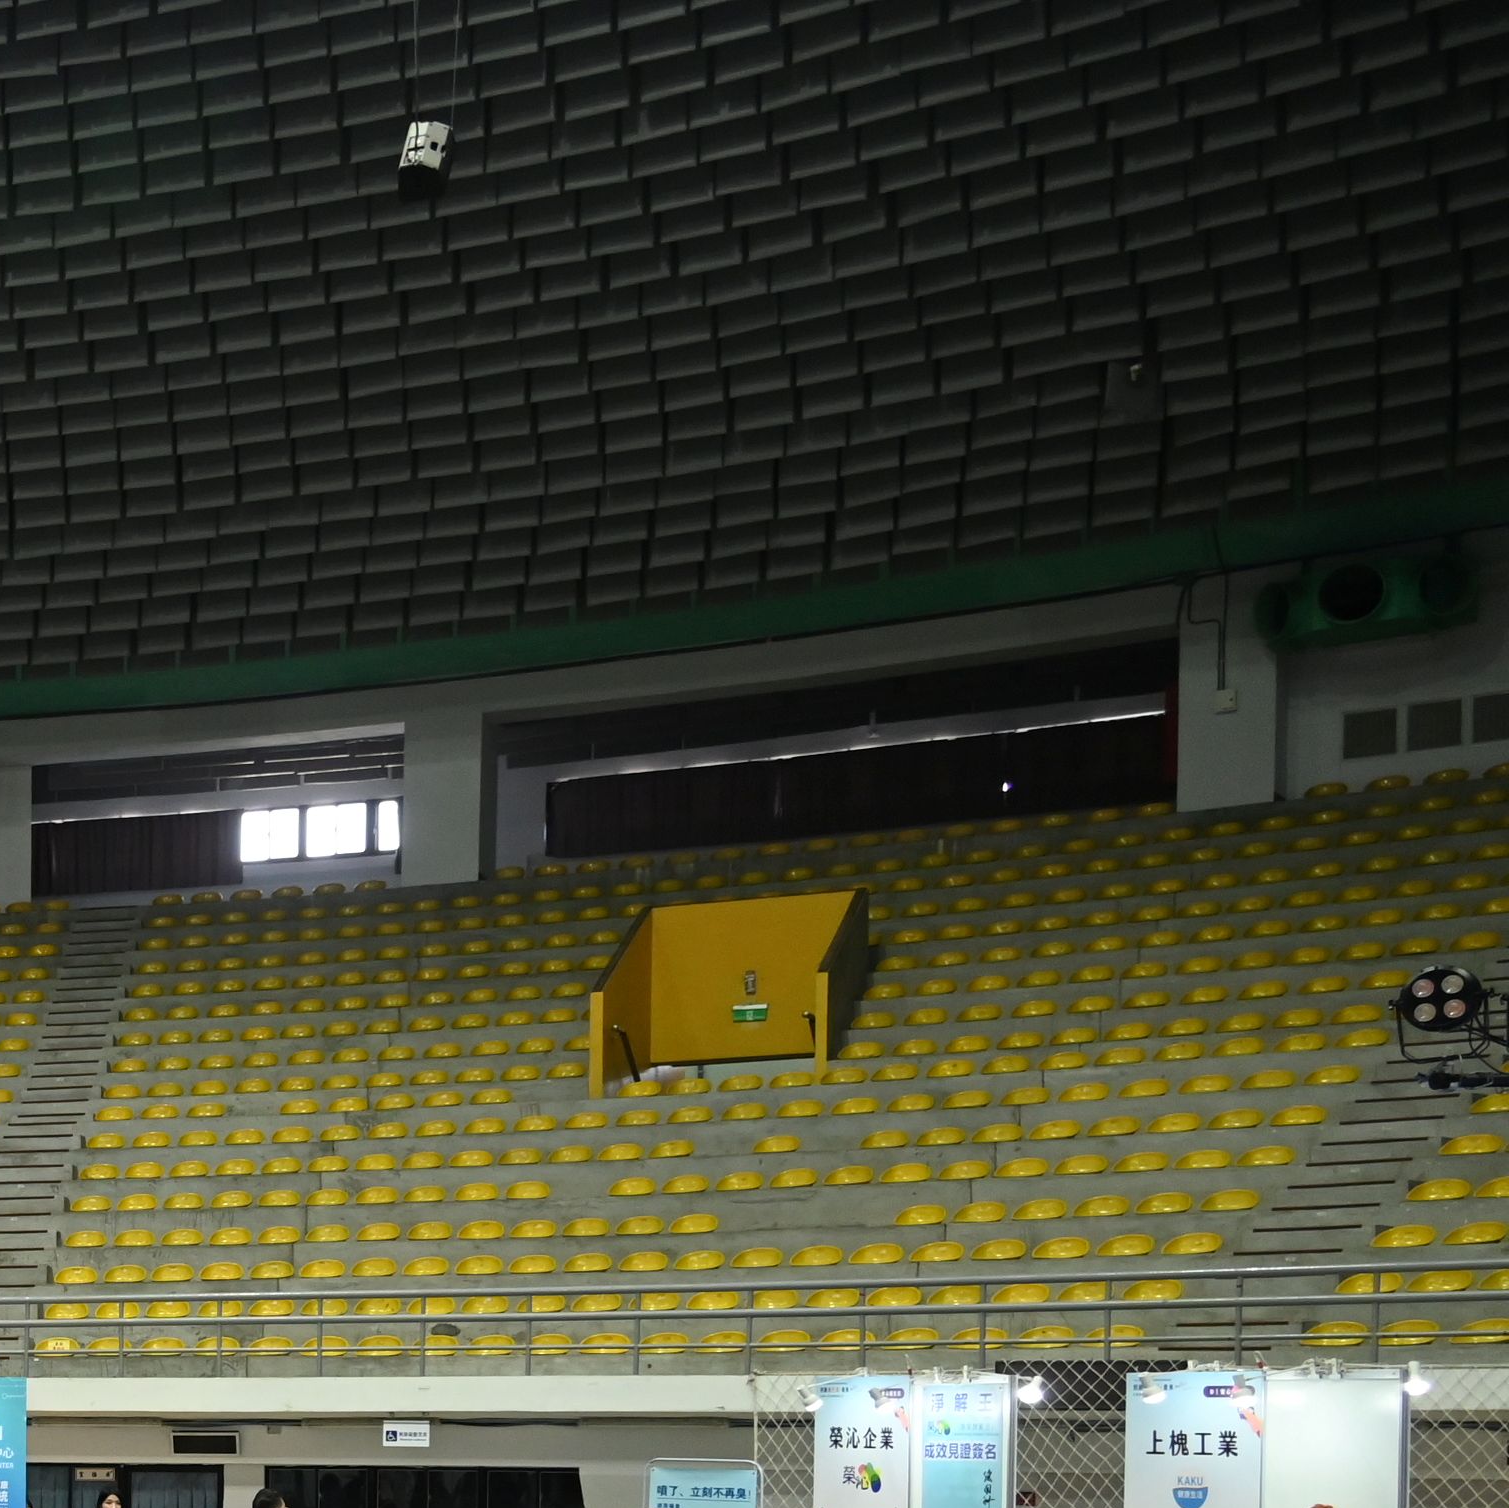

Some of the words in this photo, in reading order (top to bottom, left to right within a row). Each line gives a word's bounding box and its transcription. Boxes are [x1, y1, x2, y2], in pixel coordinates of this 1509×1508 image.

[829, 1426, 894, 1450] 榮沁企業
[1145, 1430, 1239, 1457] 上槐工業
[1177, 1476, 1204, 1486] KAKU
